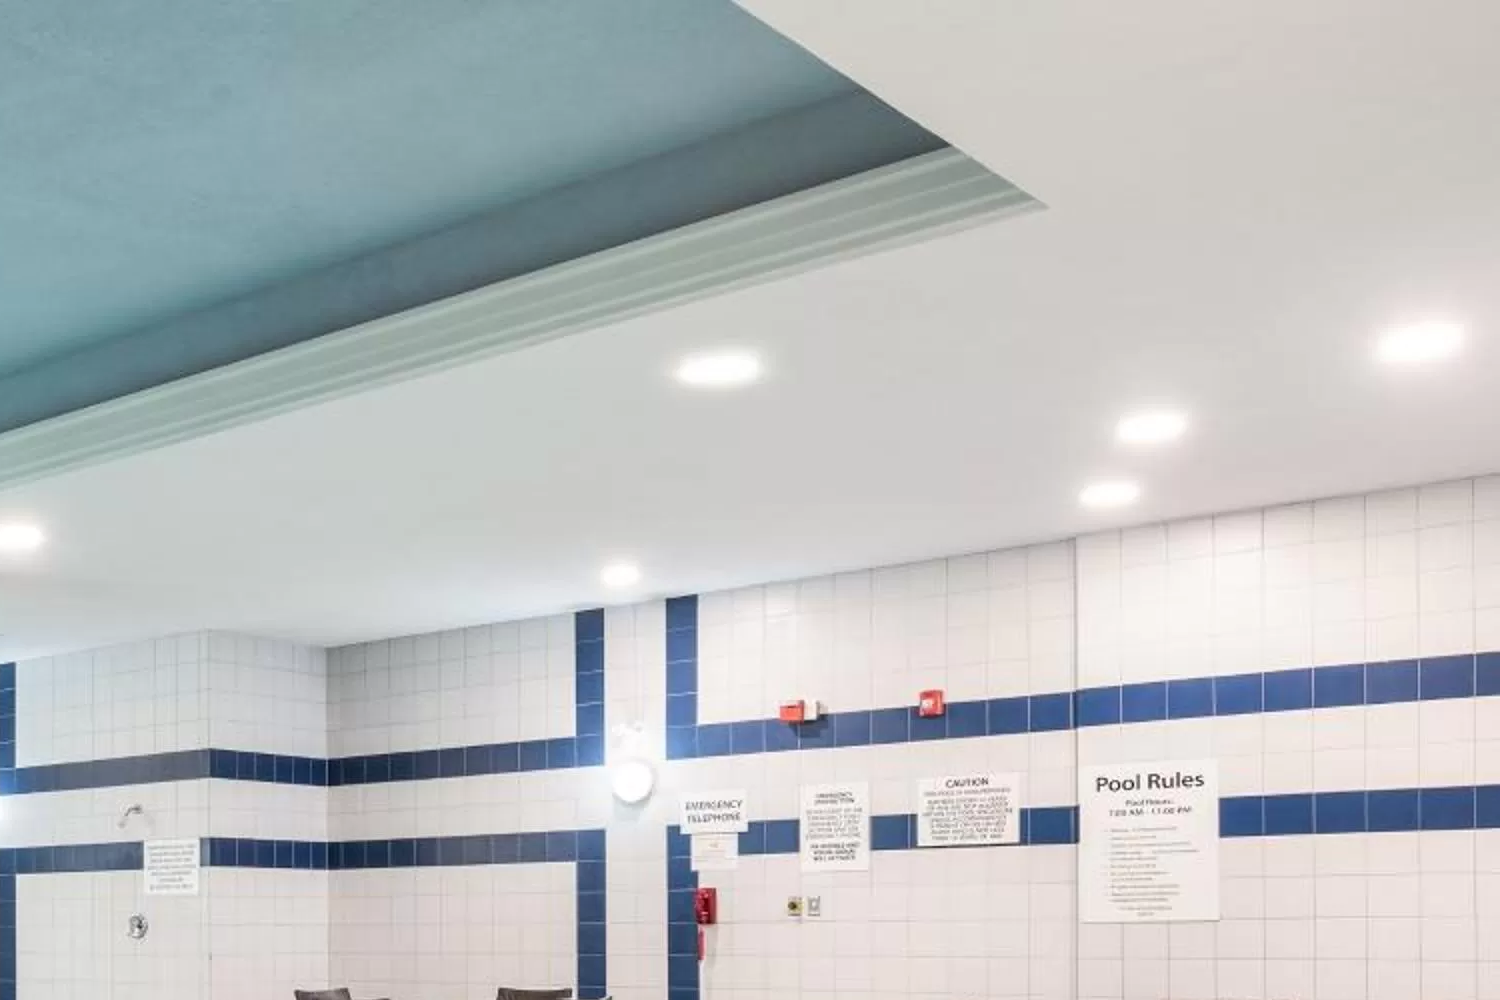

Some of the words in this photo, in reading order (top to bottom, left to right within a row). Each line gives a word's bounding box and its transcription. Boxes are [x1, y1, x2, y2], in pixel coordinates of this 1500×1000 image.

[945, 777, 989, 789] CAUTION
[1095, 773, 1141, 792] Pool
[1147, 771, 1205, 790] Rules
[685, 799, 744, 812] EMERGENCY
[687, 812, 742, 825] TELEPHONE
